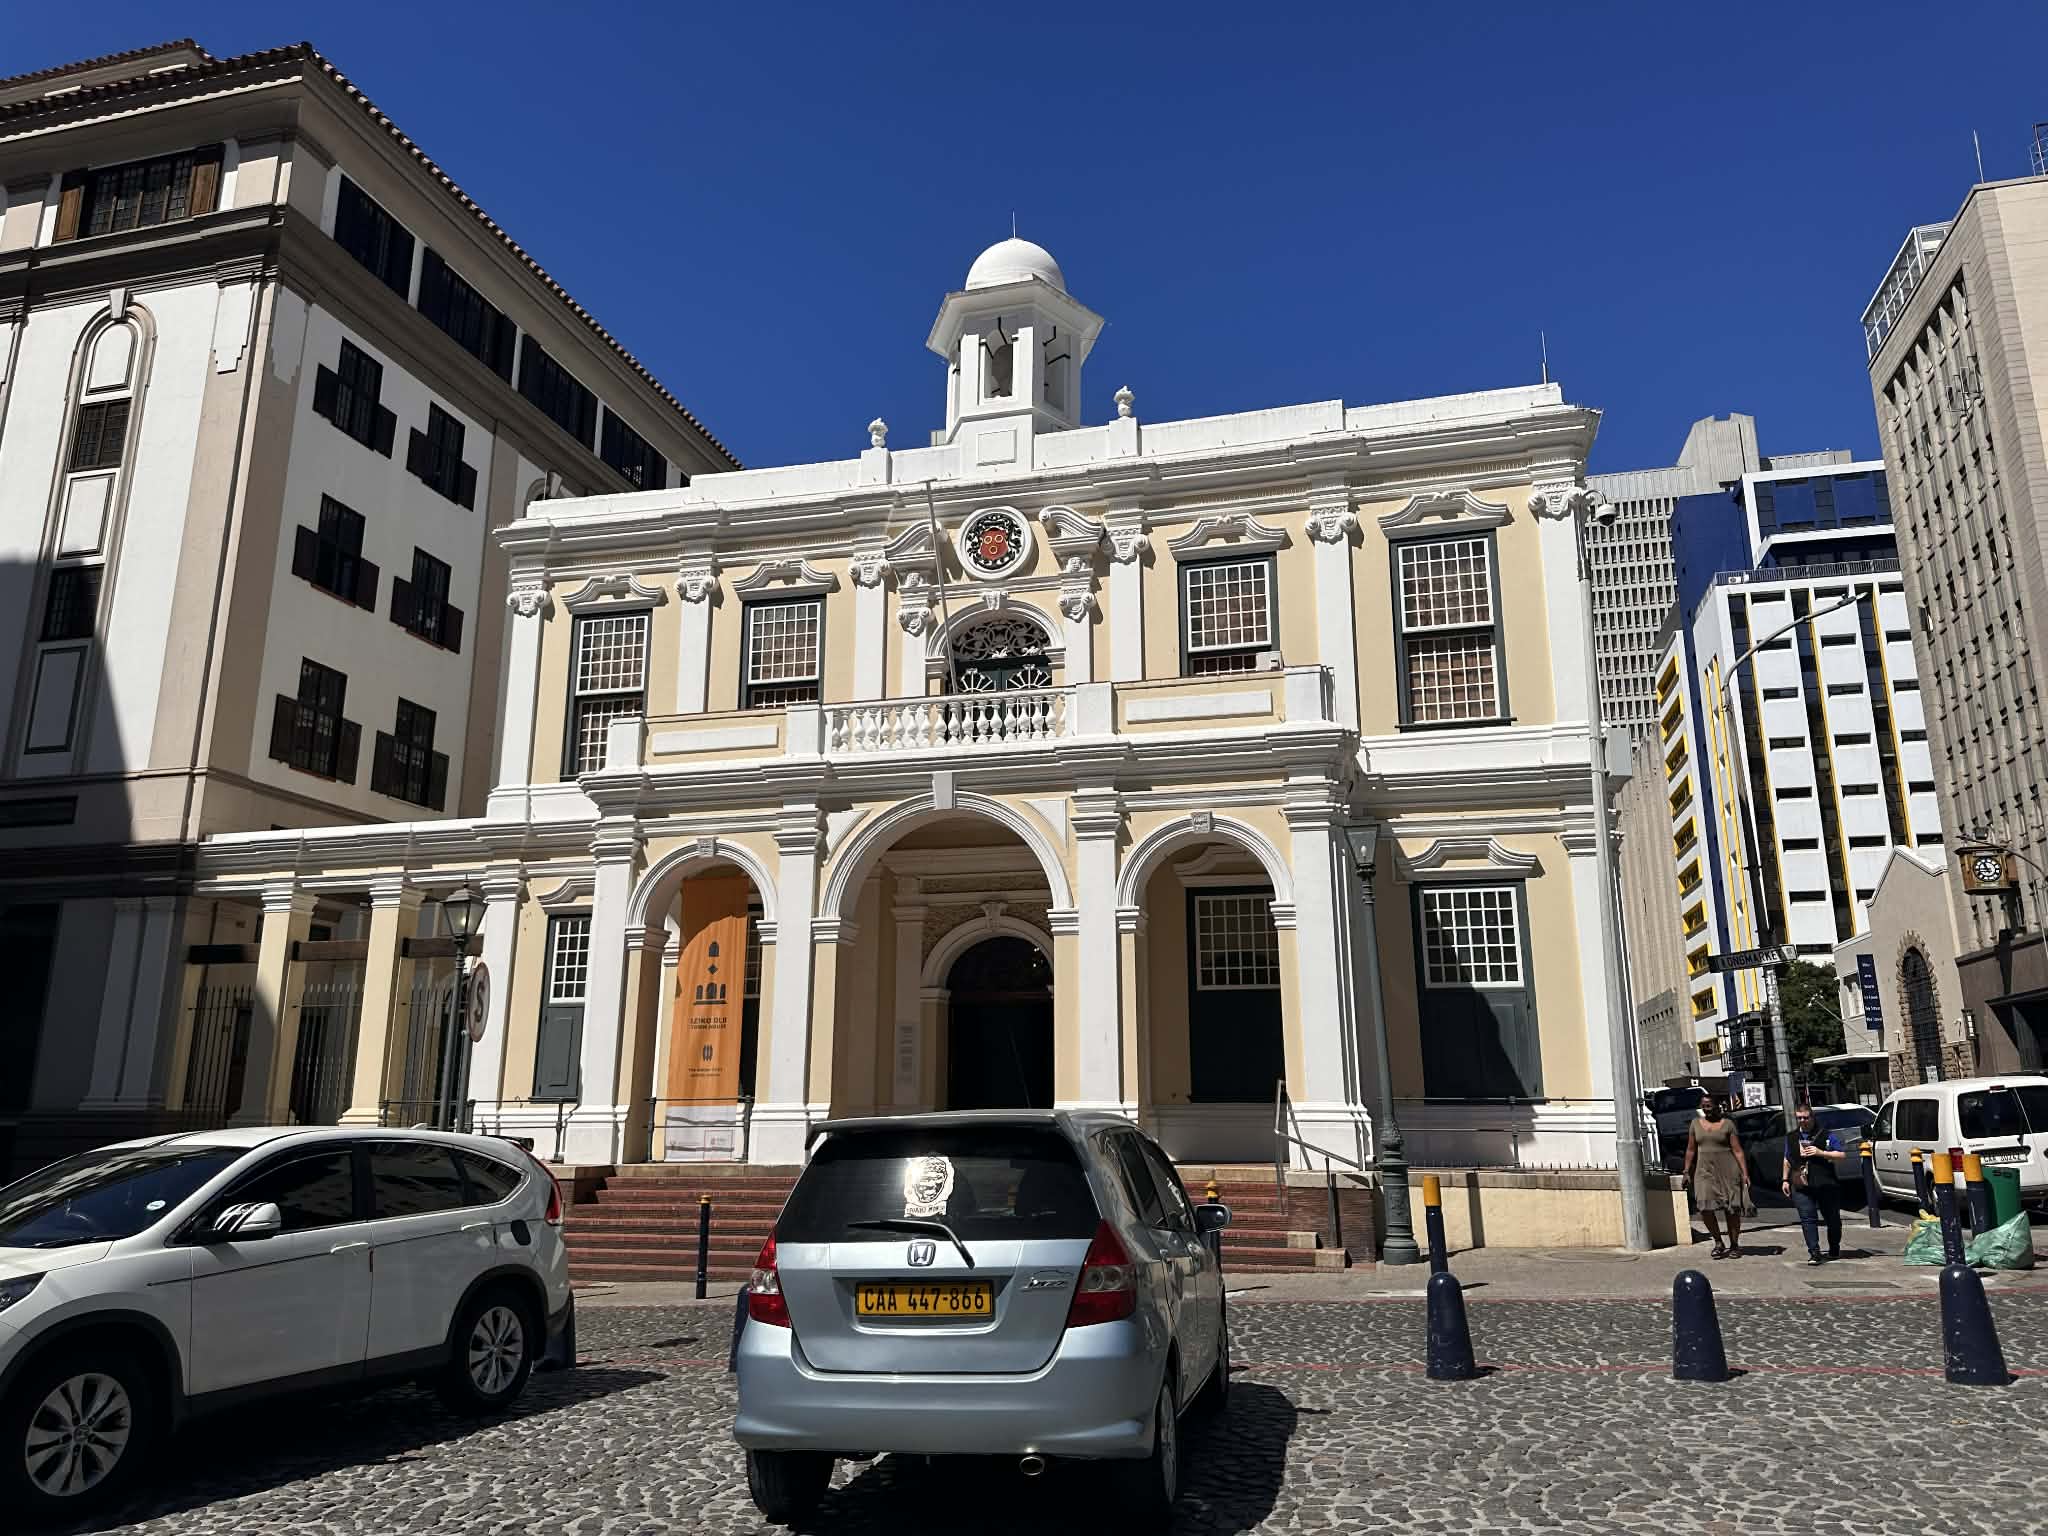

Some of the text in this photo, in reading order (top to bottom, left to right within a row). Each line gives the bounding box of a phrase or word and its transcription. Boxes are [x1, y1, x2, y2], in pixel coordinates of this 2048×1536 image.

[1721, 950, 1783, 967] LONGMARKE
[864, 1287, 984, 1311] CAA 447-866
